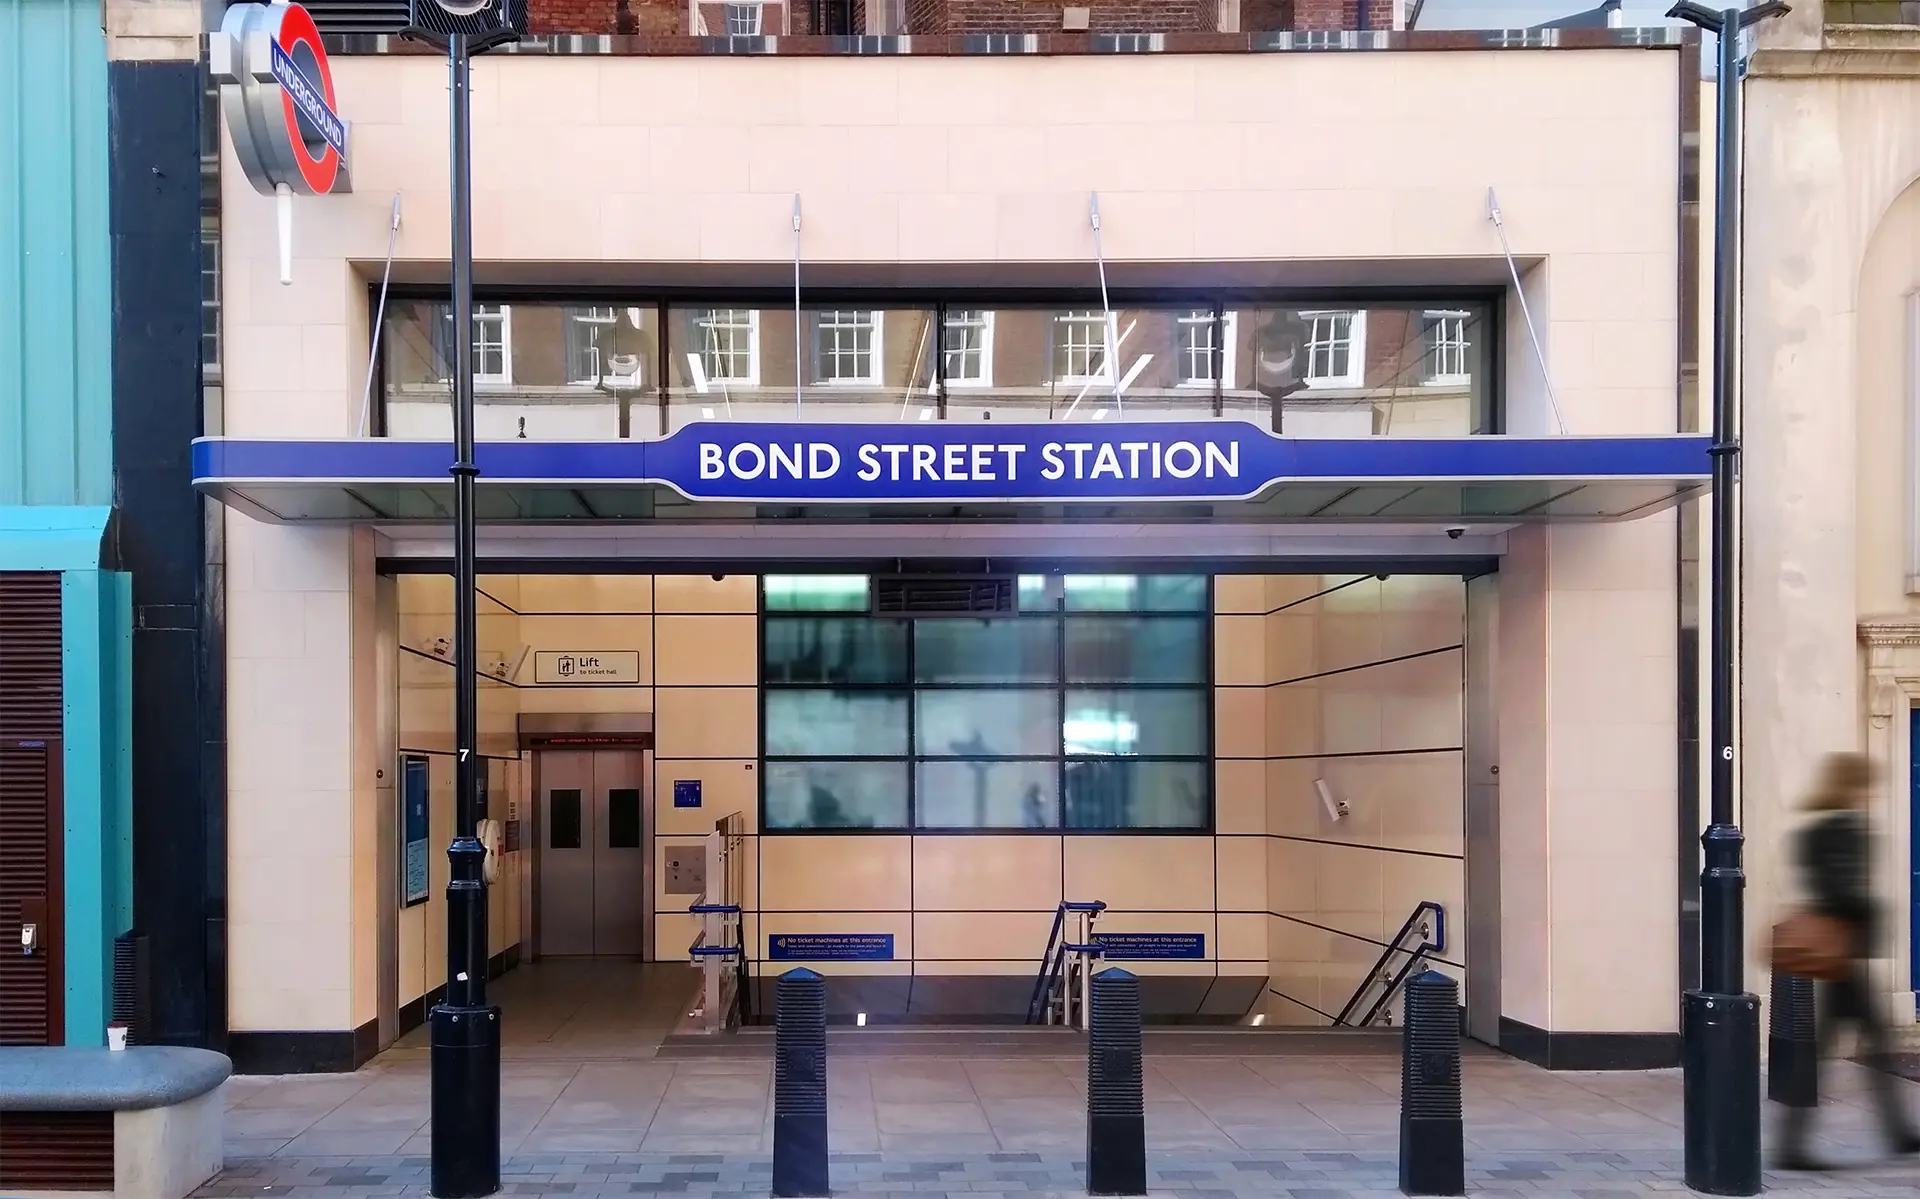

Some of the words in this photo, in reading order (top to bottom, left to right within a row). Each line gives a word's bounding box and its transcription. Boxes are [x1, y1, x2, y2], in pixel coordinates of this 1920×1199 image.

[273, 47, 342, 147] UNDERGROUND
[699, 442, 841, 480] BOND
[856, 443, 1026, 482] STREET
[1040, 440, 1239, 480] STATION
[579, 657, 600, 667] Lift
[459, 748, 470, 762] 7
[1723, 746, 1733, 760] 6
